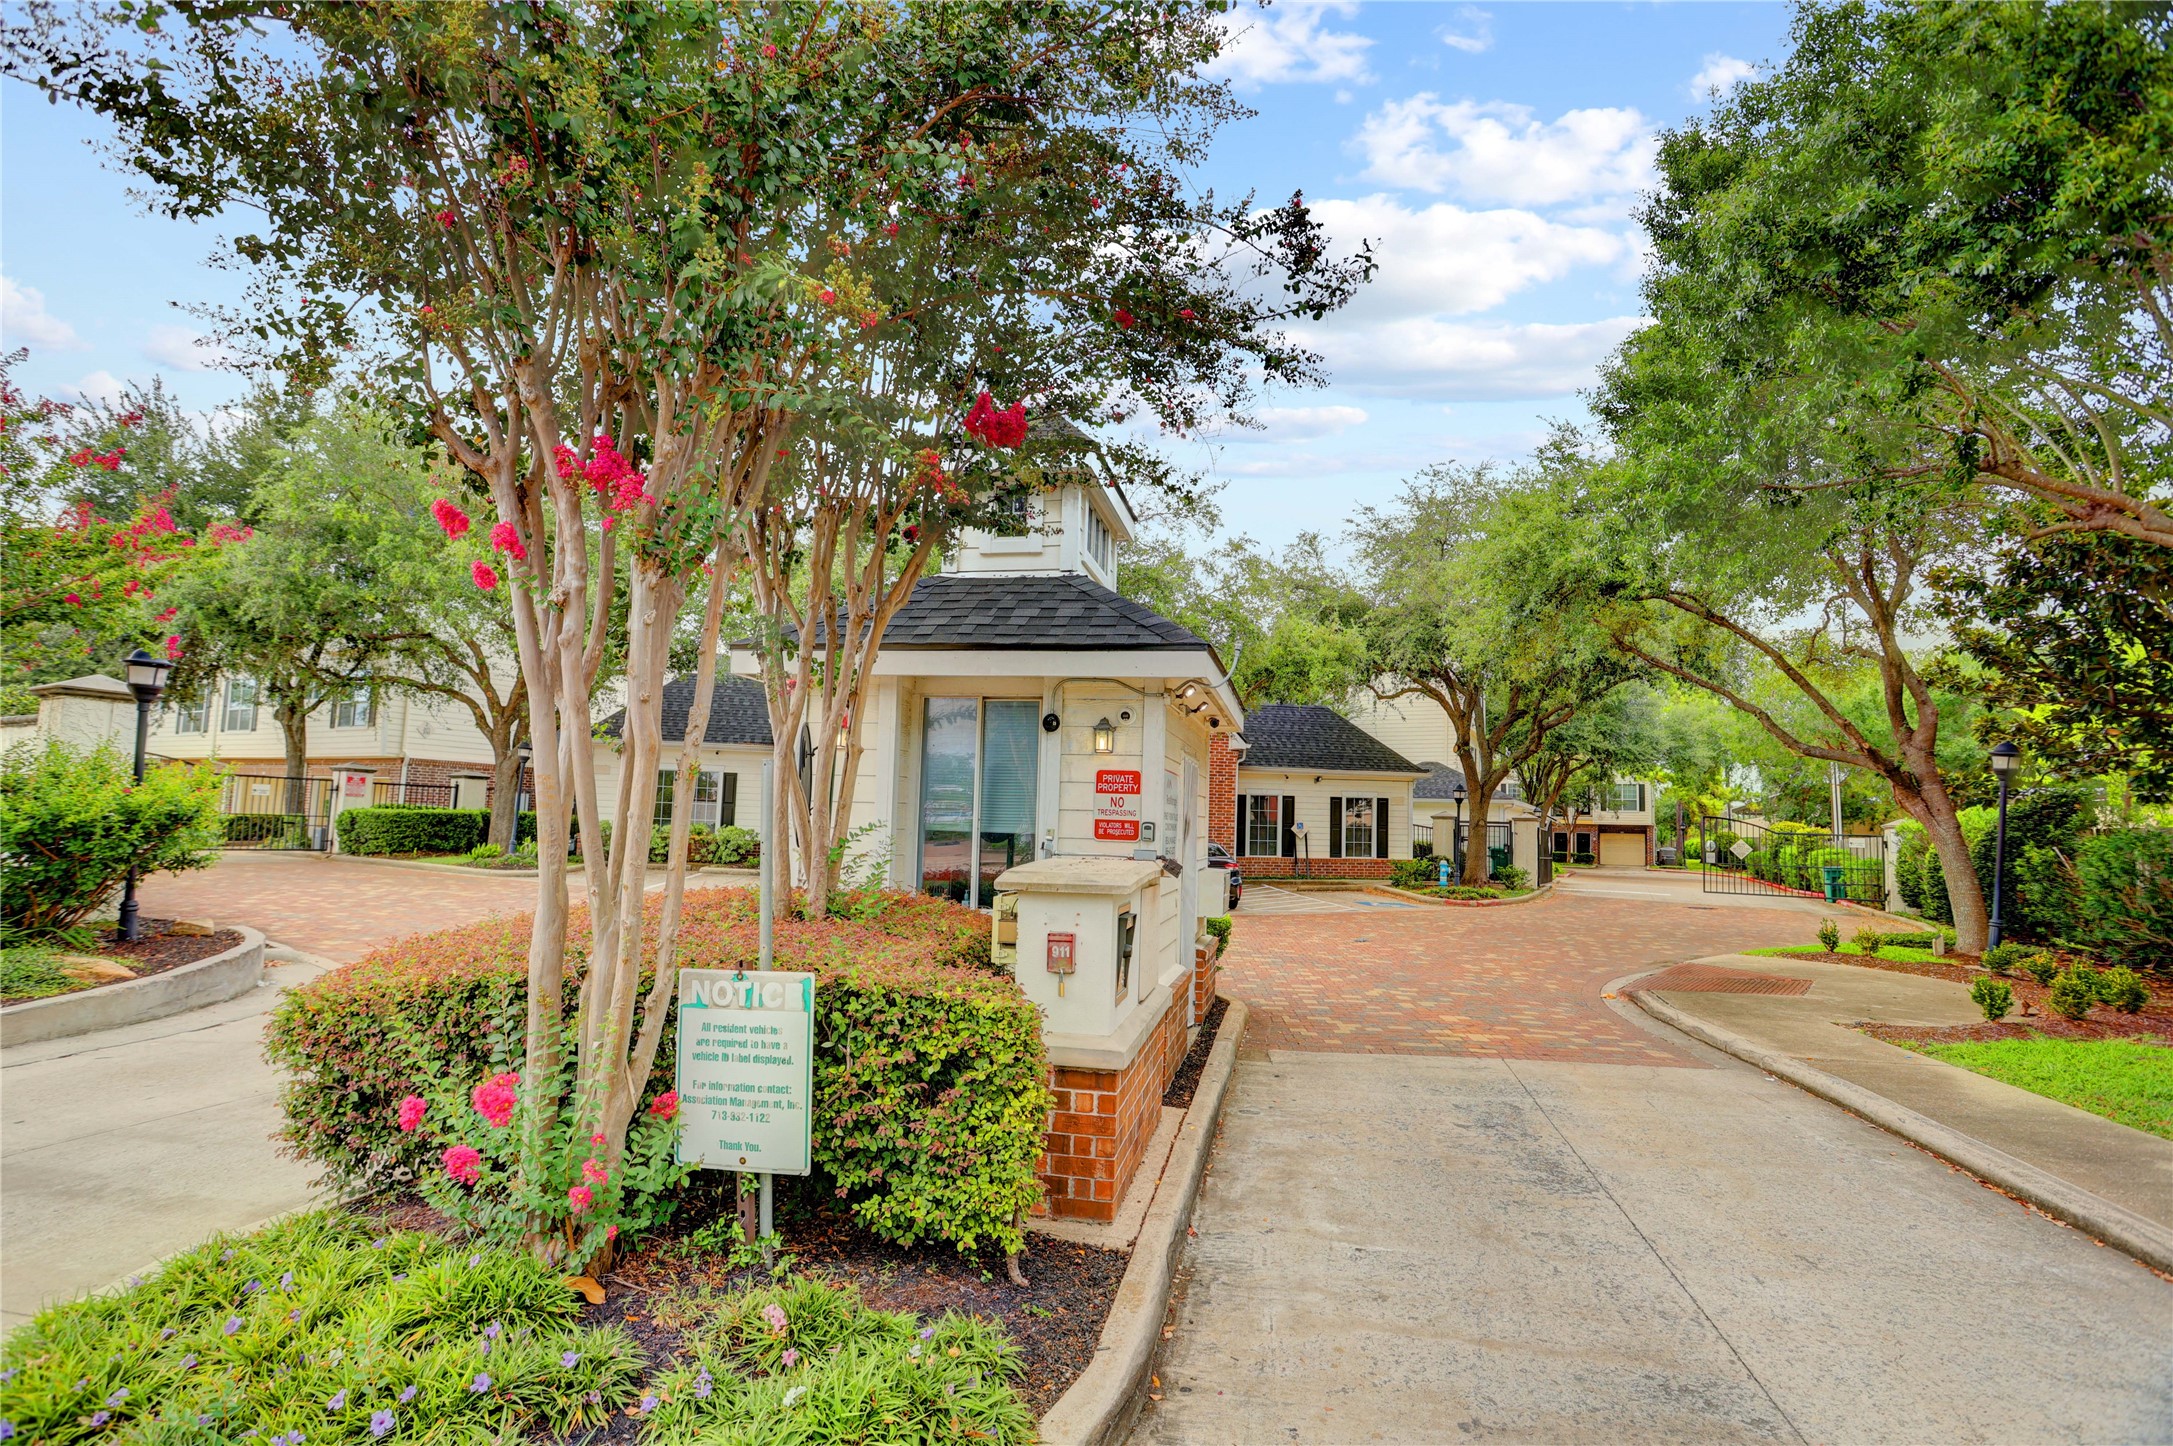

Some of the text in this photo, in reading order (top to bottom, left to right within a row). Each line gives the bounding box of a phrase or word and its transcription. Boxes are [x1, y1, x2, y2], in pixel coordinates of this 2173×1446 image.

[1103, 774, 1134, 783] PRIVATE
[1097, 783, 1139, 792] PROPERTY
[1110, 796, 1125, 808] NO
[1097, 808, 1137, 817] TRESPASSING
[1051, 945, 1070, 958] 911
[701, 1022, 783, 1035] All resident vehicles
[696, 1038, 788, 1050] are required to have a
[692, 1051, 719, 1062] vehicle
[731, 1053, 751, 1063] label
[753, 1054, 794, 1066] displayed.
[692, 1079, 792, 1095] For information contact:
[682, 1093, 803, 1110] Association Managemnt, Inc.
[719, 1139, 762, 1152] Thank You.
